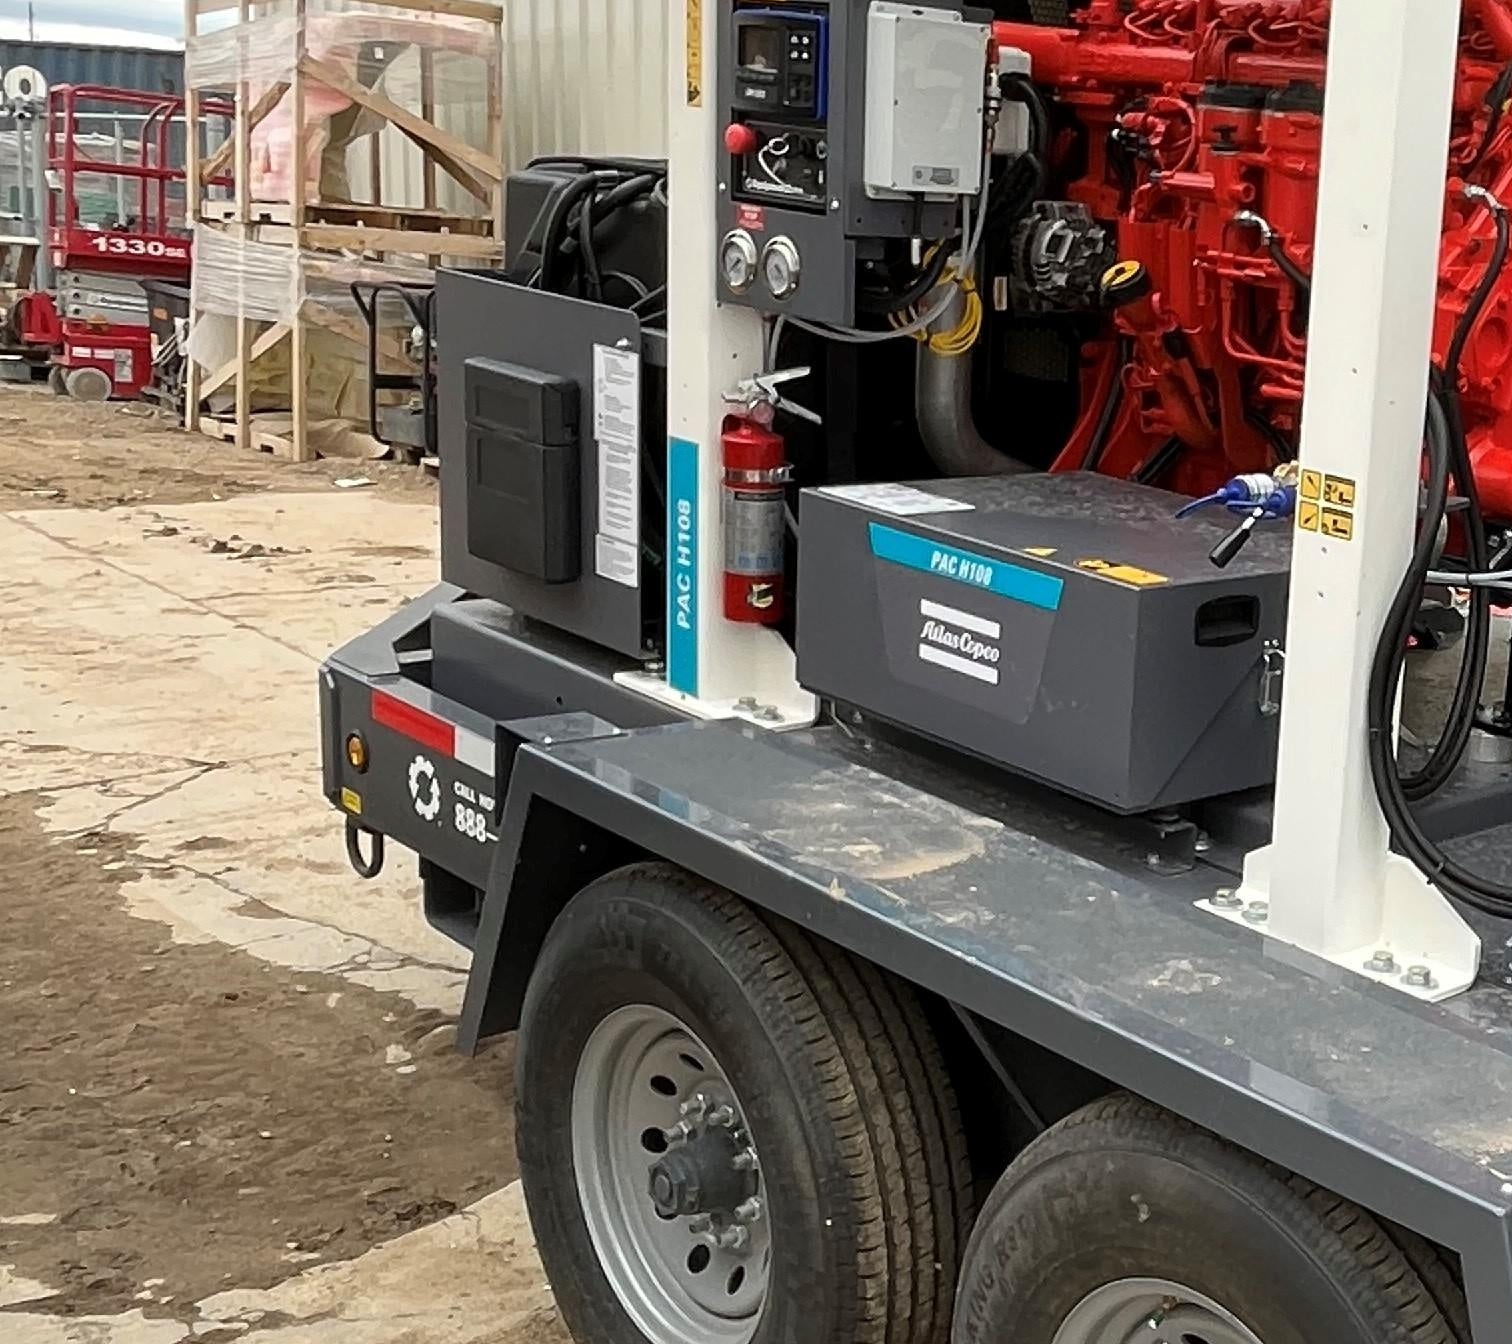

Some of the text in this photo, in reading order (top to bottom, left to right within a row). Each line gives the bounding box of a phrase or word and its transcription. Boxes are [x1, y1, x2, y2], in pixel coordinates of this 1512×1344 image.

[676, 499, 692, 630] PAC H108
[931, 550, 993, 586] PAC H108
